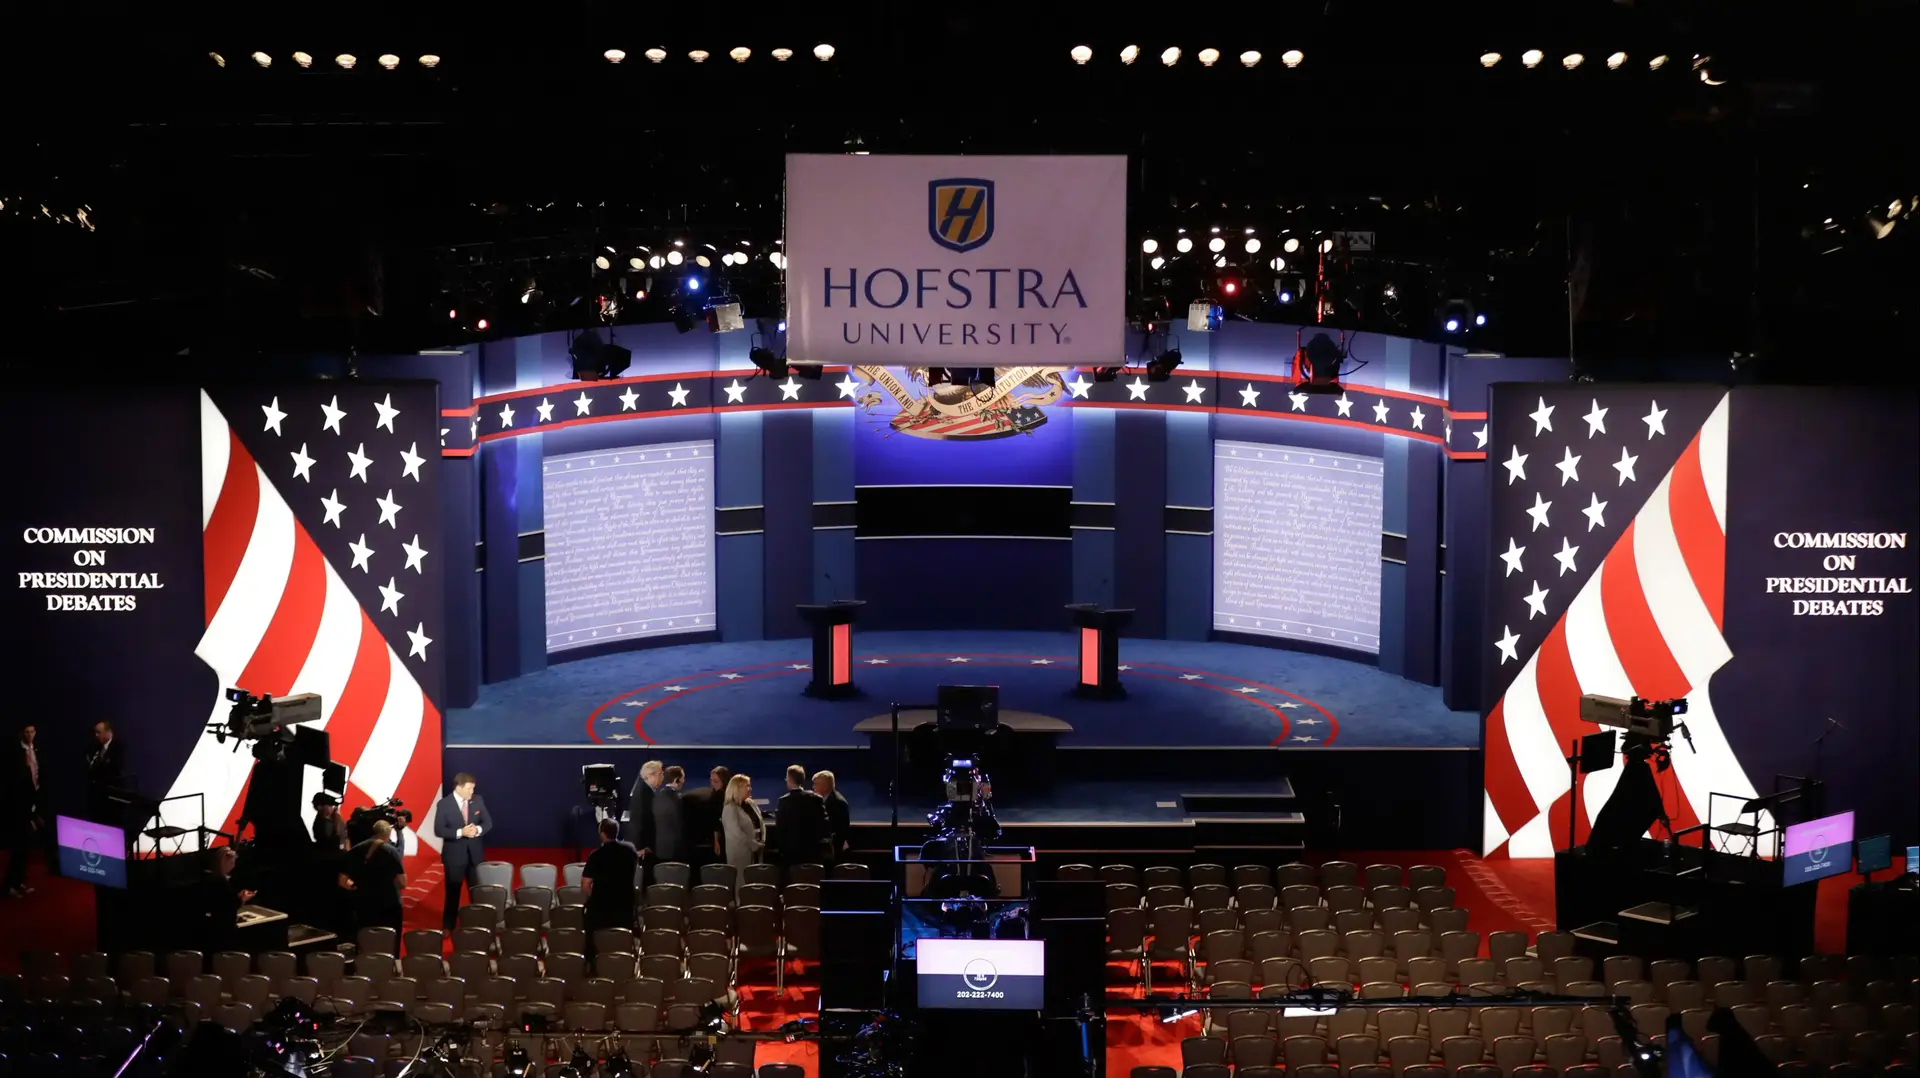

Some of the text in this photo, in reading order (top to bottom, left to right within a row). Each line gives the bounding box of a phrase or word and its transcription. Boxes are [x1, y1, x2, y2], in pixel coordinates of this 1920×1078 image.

[823, 267, 1089, 309] HOFSTRA
[843, 322, 1067, 346] UNIVERSITY
[878, 372, 902, 396] UNION
[898, 394, 914, 410] AND
[957, 402, 974, 414] THE
[23, 528, 155, 544] COMMISSION
[1773, 532, 1907, 549] COMMISSION
[73, 550, 106, 566] ON
[1823, 555, 1856, 571] ON
[18, 572, 164, 589] PRESIDENTIAL
[1766, 577, 1912, 594] PRESIDENTIAL
[46, 595, 136, 612] DEBATES
[1793, 600, 1884, 616] DEBATES
[956, 990, 1004, 999] 202-222-7400
